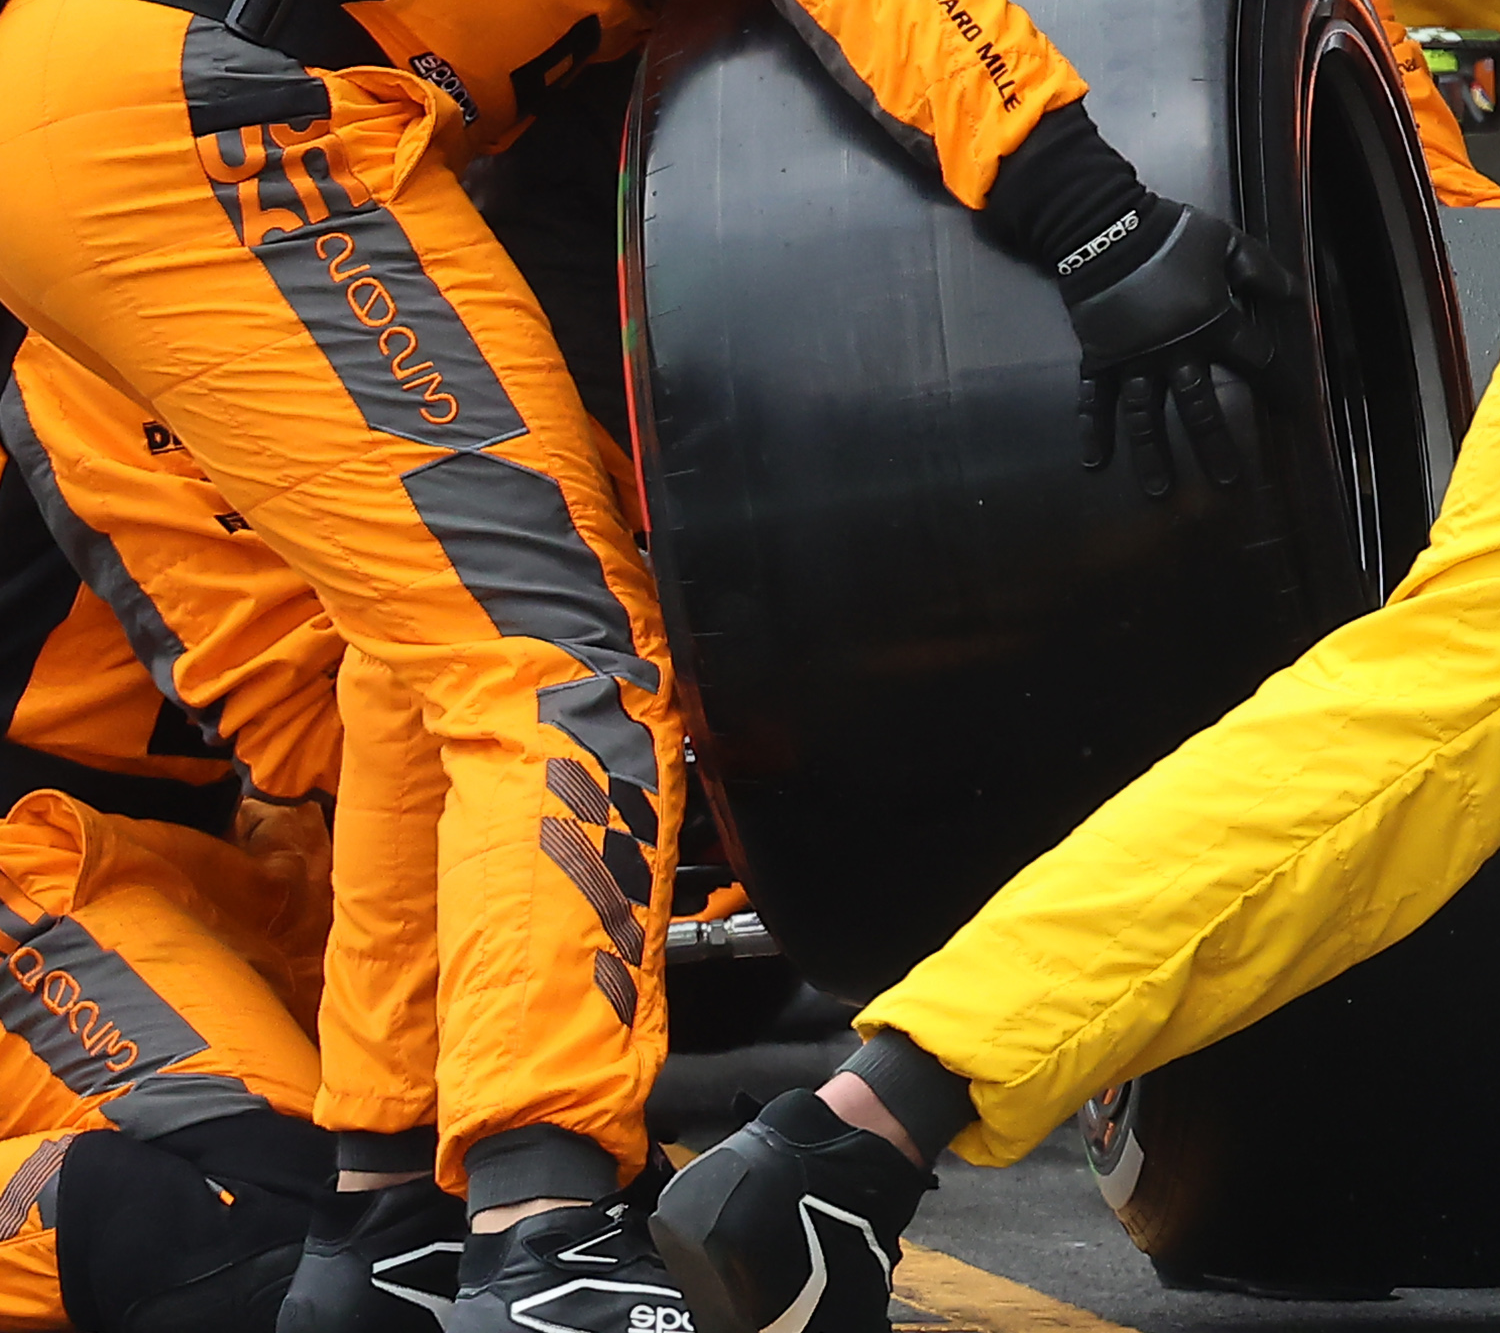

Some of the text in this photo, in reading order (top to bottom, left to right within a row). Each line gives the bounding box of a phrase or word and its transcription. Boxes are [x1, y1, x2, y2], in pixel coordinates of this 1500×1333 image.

[975, 41, 1022, 113] MILLE
[1057, 209, 1140, 277] sparco
[314, 231, 459, 425] 2023
